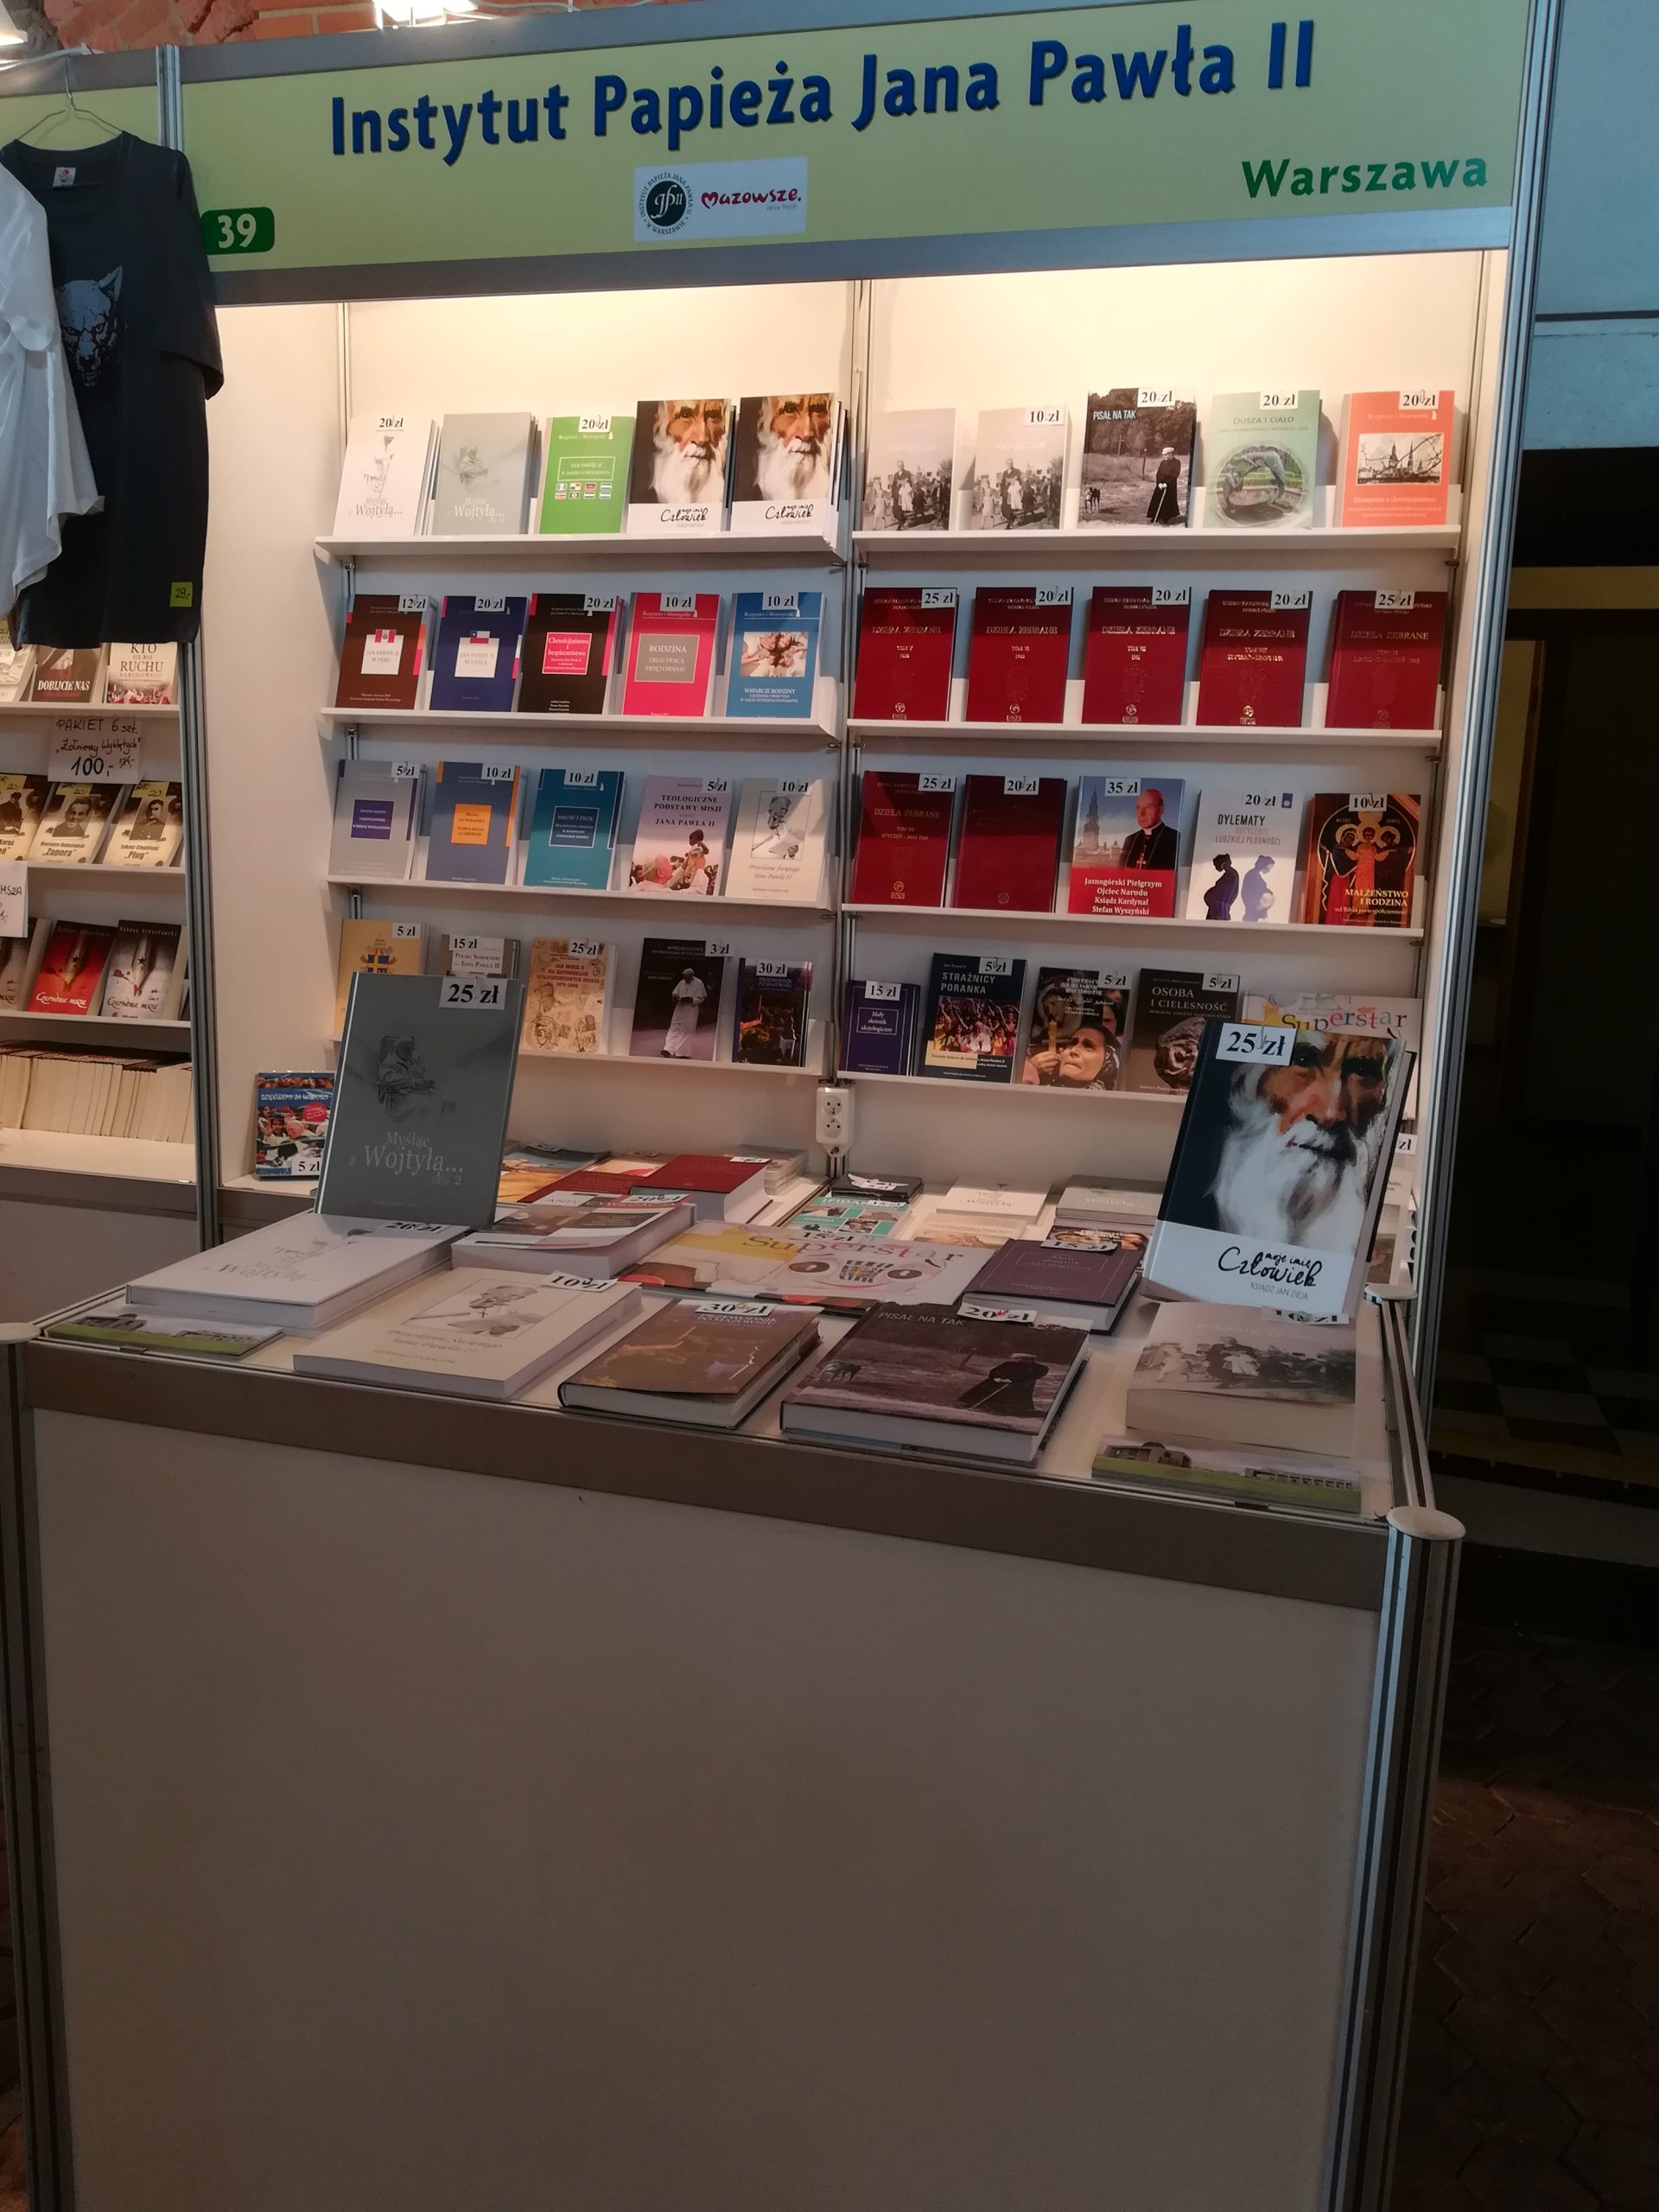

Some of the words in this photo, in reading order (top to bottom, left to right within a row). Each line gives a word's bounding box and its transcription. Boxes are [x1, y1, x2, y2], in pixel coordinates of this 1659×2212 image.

[333, 84, 569, 166] Instytut
[594, 60, 831, 150] Papieża
[849, 53, 1000, 130] Jana
[1030, 25, 1235, 106] Pawła
[1268, 20, 1313, 90] II
[1243, 156, 1487, 199] Warszawa
[216, 213, 257, 250] 39
[1141, 391, 1157, 404] 20
[1262, 395, 1279, 406] 20
[1402, 394, 1419, 406] 20
[1029, 410, 1044, 423] 10
[1093, 410, 1111, 420] PISAŁ
[1112, 410, 1122, 420] NA
[1123, 410, 1136, 419] TAK
[379, 418, 391, 428] 20
[582, 419, 594, 429] 20
[925, 593, 940, 603] 25
[1039, 591, 1052, 602] 20
[1155, 590, 1172, 601] 20
[1274, 594, 1290, 605] 20
[1378, 594, 1395, 606] 25
[401, 598, 414, 608] 12
[478, 599, 491, 608] 20
[588, 598, 600, 607] 20
[665, 597, 678, 607] 10
[767, 596, 780, 607] 10
[130, 643, 157, 654] KTO
[120, 661, 164, 672] RUCHU
[37, 680, 73, 691] DOBIJCIE
[74, 680, 91, 691] NAS
[56, 719, 103, 732] PAKIET
[111, 719, 119, 732] 6
[71, 757, 113, 777] 100,-
[397, 766, 403, 776] 5
[486, 767, 498, 778] 10
[569, 772, 581, 783] 10
[923, 778, 937, 788] 25
[707, 781, 715, 791] 5
[782, 781, 795, 792] 10
[1007, 779, 1020, 791] 20
[1108, 782, 1123, 793] 35
[662, 795, 719, 804] TEOLOGICZNE
[1245, 794, 1261, 805] 20
[1353, 797, 1367, 808] 10
[654, 804, 699, 812] PODSTAWY
[874, 808, 901, 817] DZIEŁA
[905, 810, 940, 818] ZEBRANE
[1217, 814, 1265, 827] DYLEMATY
[1215, 836, 1244, 844] LUDZKIEJ
[1246, 836, 1281, 845] PŁODNOŚCI
[1084, 877, 1125, 887] Jasnogórski
[1127, 879, 1162, 888] Pielgrzym
[1096, 887, 1120, 896] Ojciec
[1344, 887, 1408, 898] MAŁŻEŃSTWO
[1118, 897, 1148, 906] Kardynał
[1364, 898, 1408, 906] RODZINA
[1114, 906, 1149, 916] Wyszyński
[397, 926, 404, 936] 5
[453, 938, 466, 949] 15
[571, 943, 584, 954] 25
[710, 944, 716, 954] 3
[759, 963, 772, 973] 30
[985, 961, 992, 972] 5
[943, 972, 995, 984] STRAŻNICY
[1104, 975, 1112, 984] 5
[1209, 977, 1217, 988] 5
[448, 983, 474, 1003] 25
[480, 985, 499, 1004] zł
[871, 985, 883, 996] 15
[941, 982, 986, 995] PORANKA
[1152, 987, 1194, 999] OSOBA
[1158, 999, 1227, 1013] CIELESNOŚĆ
[1281, 1006, 1407, 1032] Superstar
[1225, 1031, 1256, 1053] 25
[1262, 1035, 1287, 1057] zł
[298, 1161, 306, 1172] 5
[364, 1145, 464, 1177] Wojtyłą...
[743, 1236, 963, 1262] Superstar
[1217, 1246, 1322, 1287] Człowiek
[550, 1274, 579, 1287] 10
[1250, 1281, 1274, 1293] KSIĄDZ
[1276, 1286, 1289, 1295] JAN
[1290, 1288, 1309, 1300] ZIEJA
[702, 1303, 730, 1313] 30
[966, 1307, 995, 1319] 20
[878, 1311, 912, 1322] PISAŁ
[918, 1315, 937, 1324] NA
[940, 1318, 966, 1327] TAK
